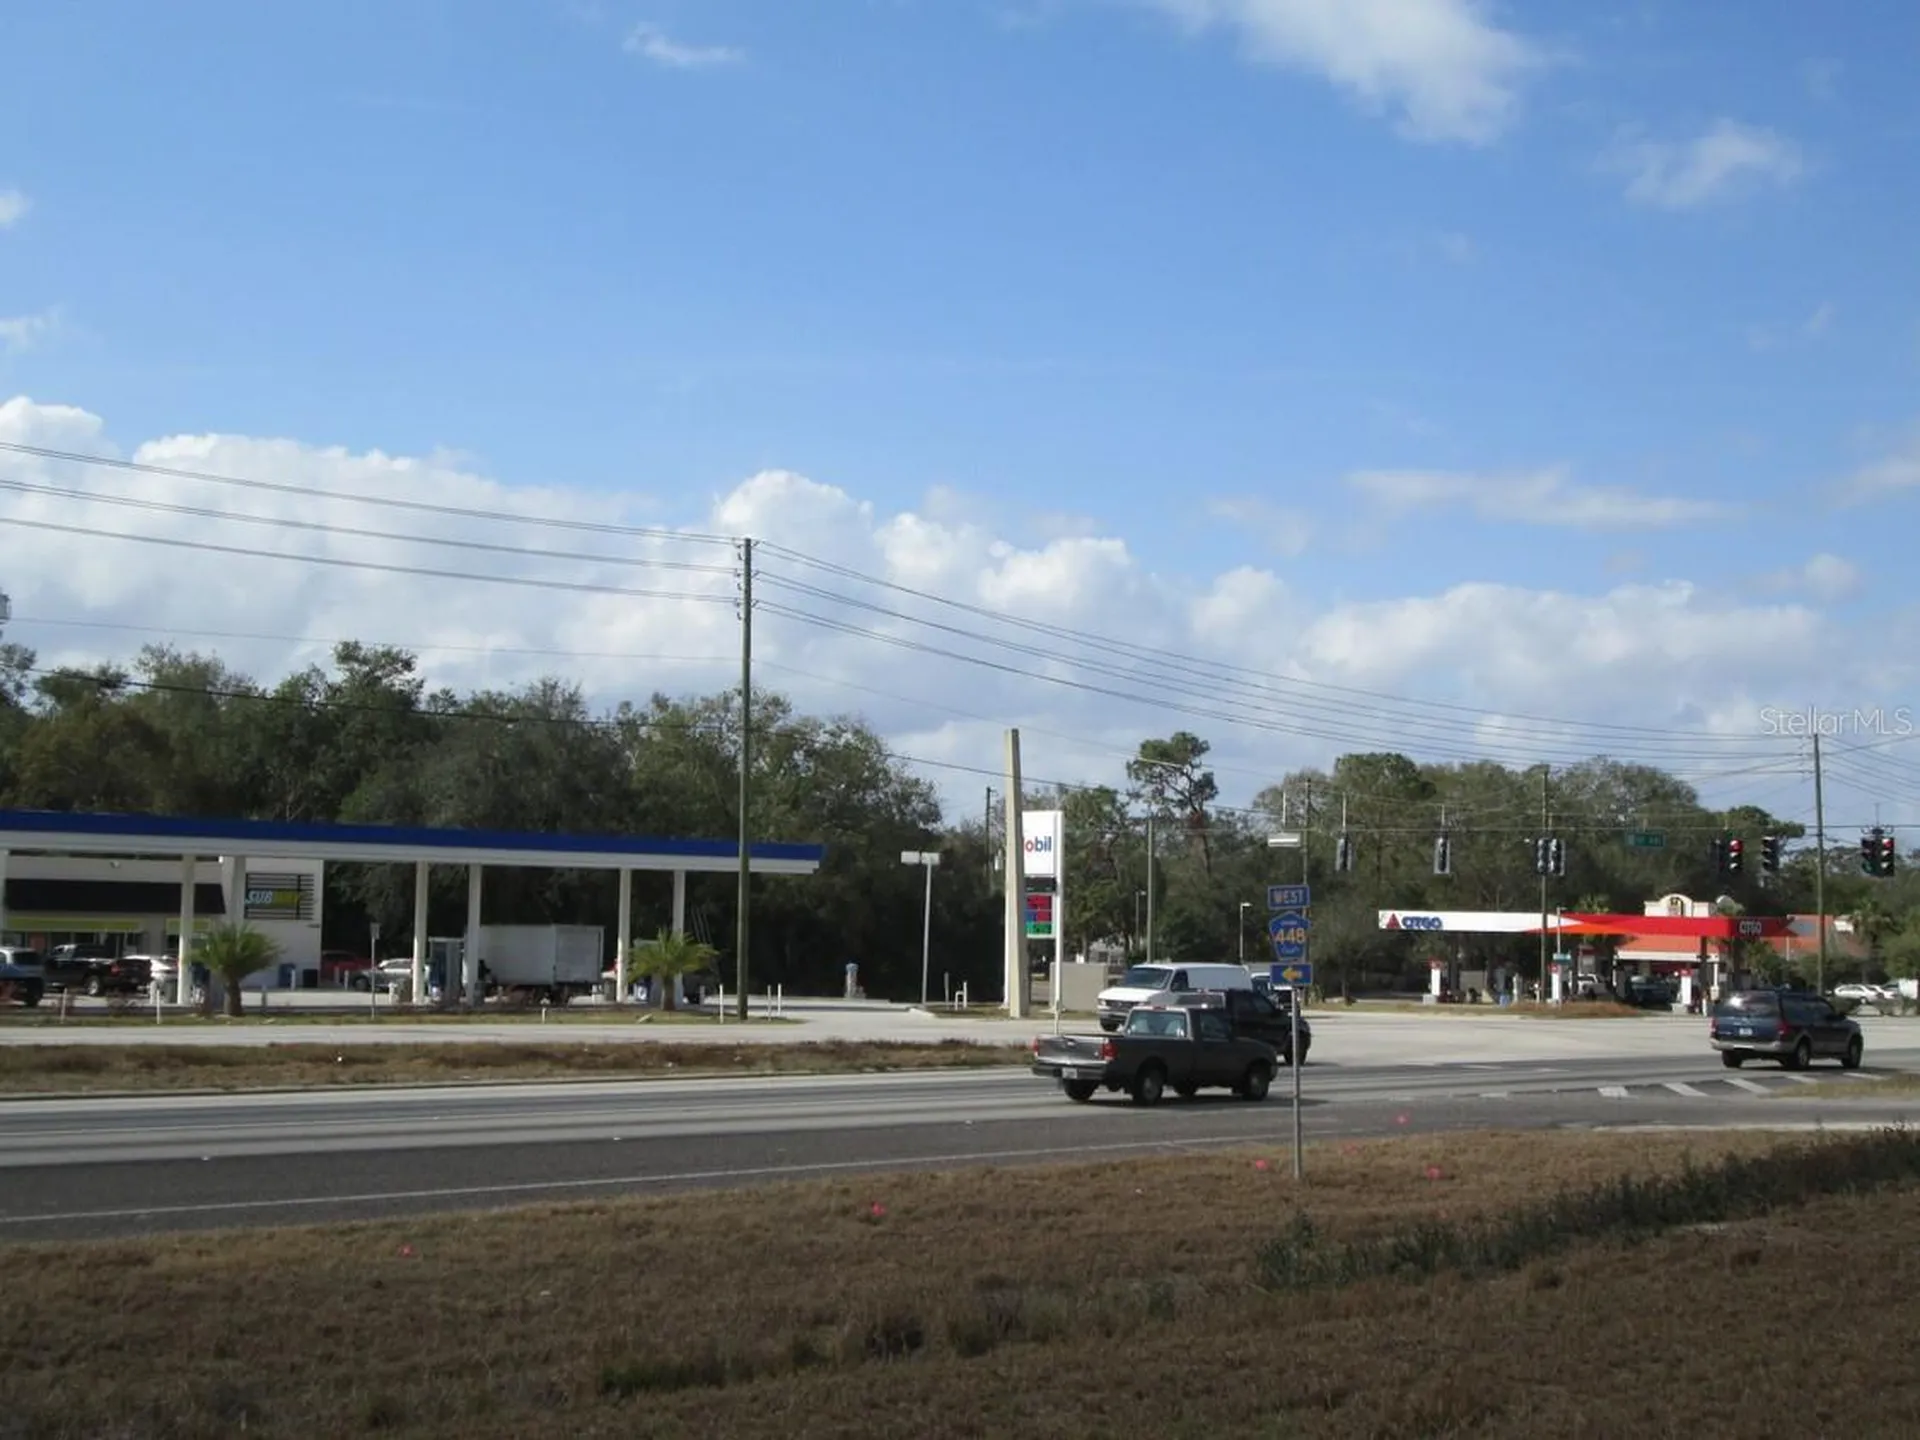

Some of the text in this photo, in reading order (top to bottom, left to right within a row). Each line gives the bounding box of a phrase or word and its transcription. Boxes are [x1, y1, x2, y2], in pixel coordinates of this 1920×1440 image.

[1022, 835, 1052, 852] obil
[1273, 889, 1305, 905] WEST
[1276, 928, 1305, 944] 448
